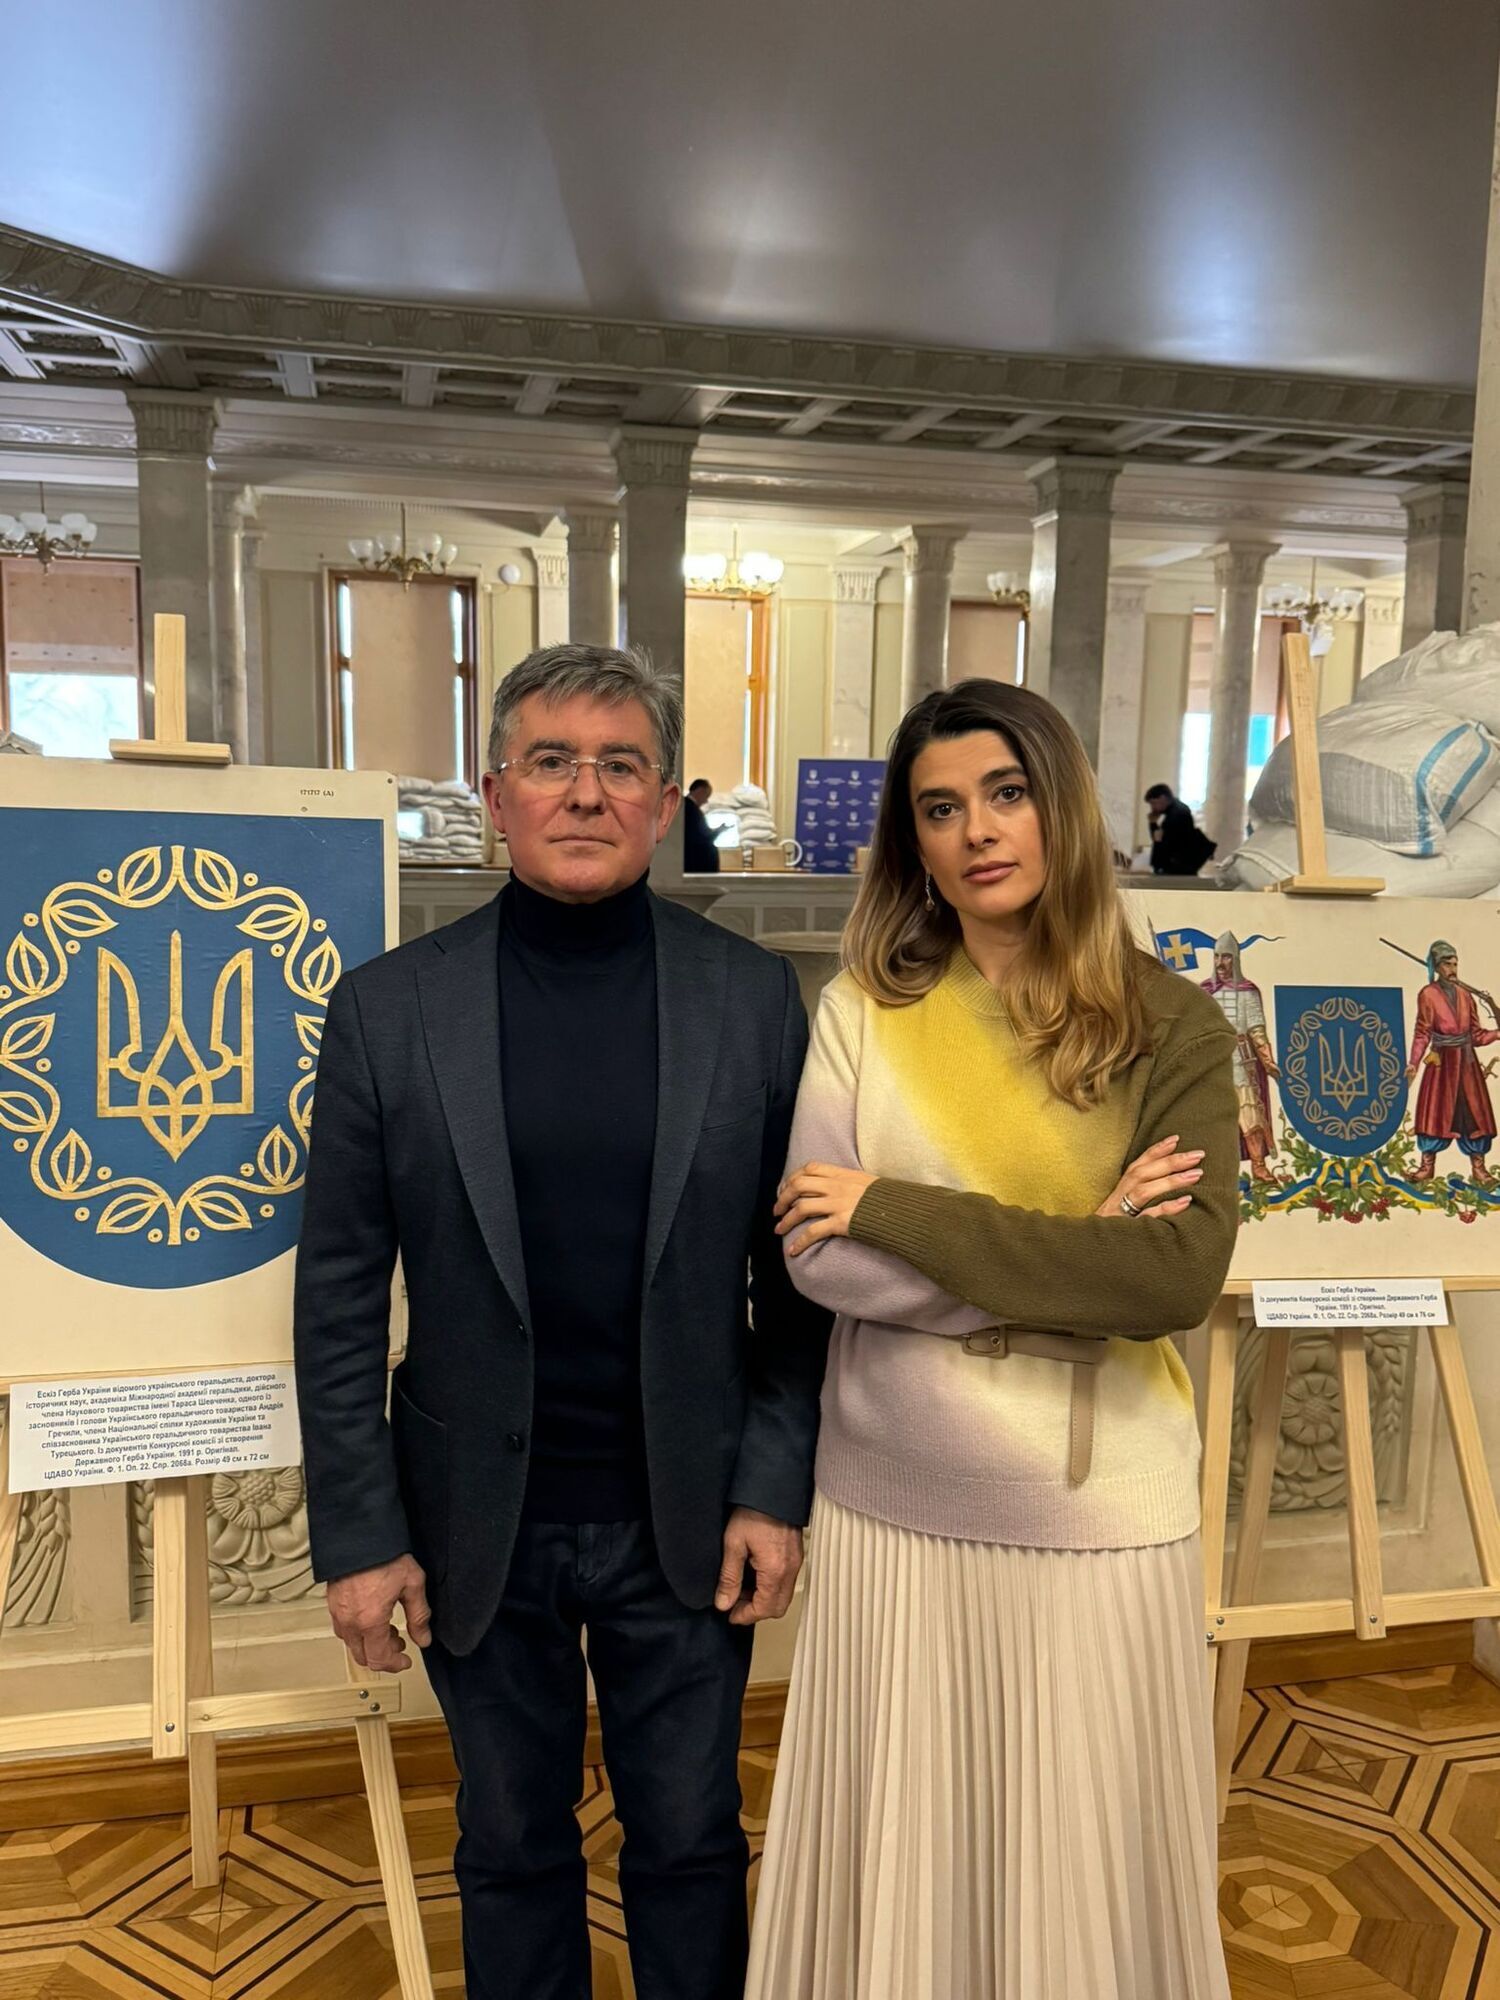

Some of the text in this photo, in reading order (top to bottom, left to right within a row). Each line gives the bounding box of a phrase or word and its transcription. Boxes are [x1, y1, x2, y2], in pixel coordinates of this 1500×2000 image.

[25, 1381, 286, 1410] історичних наук, академіка Міжнародної академії геральдики, дійсного
[37, 1374, 274, 1398] Ескіз Герба України відомого українського геральдиста, доктора
[28, 1418, 74, 1428] засновників
[80, 1416, 107, 1424] голови
[108, 1411, 157, 1423] Українського
[158, 1408, 214, 1419] геральдичного
[215, 1404, 257, 1414] товариства
[258, 1400, 283, 1411] Андрія
[65, 1405, 105, 1416] Наукового
[106, 1403, 149, 1413] товариства
[150, 1400, 169, 1408] імені
[170, 1398, 196, 1408] Тараса
[198, 1395, 237, 1406] Шевченка,
[238, 1394, 264, 1403] одного
[41, 1422, 271, 1447] співзасновника Українського геральдичного товариства Івана
[47, 1427, 81, 1438] Гречили,
[83, 1426, 106, 1434] члена
[107, 1421, 158, 1433] Національної
[158, 1419, 183, 1428] спілки
[184, 1415, 226, 1427] художників
[227, 1413, 256, 1423] України
[50, 1446, 95, 1459] Турецького.
[105, 1442, 147, 1454] документів
[148, 1438, 190, 1450] Конкурсної
[191, 1436, 216, 1445] комісії
[224, 1433, 263, 1444] створення
[75, 1454, 120, 1466] Державного
[122, 1452, 144, 1462] Герба
[146, 1449, 176, 1460] України.
[178, 1448, 194, 1456] 1991
[204, 1444, 239, 1455] Оригінал.
[44, 1468, 72, 1479] ЦДАВО
[74, 1466, 104, 1477] України.
[152, 1460, 169, 1470] Спр.
[194, 1456, 220, 1466] Розмір
